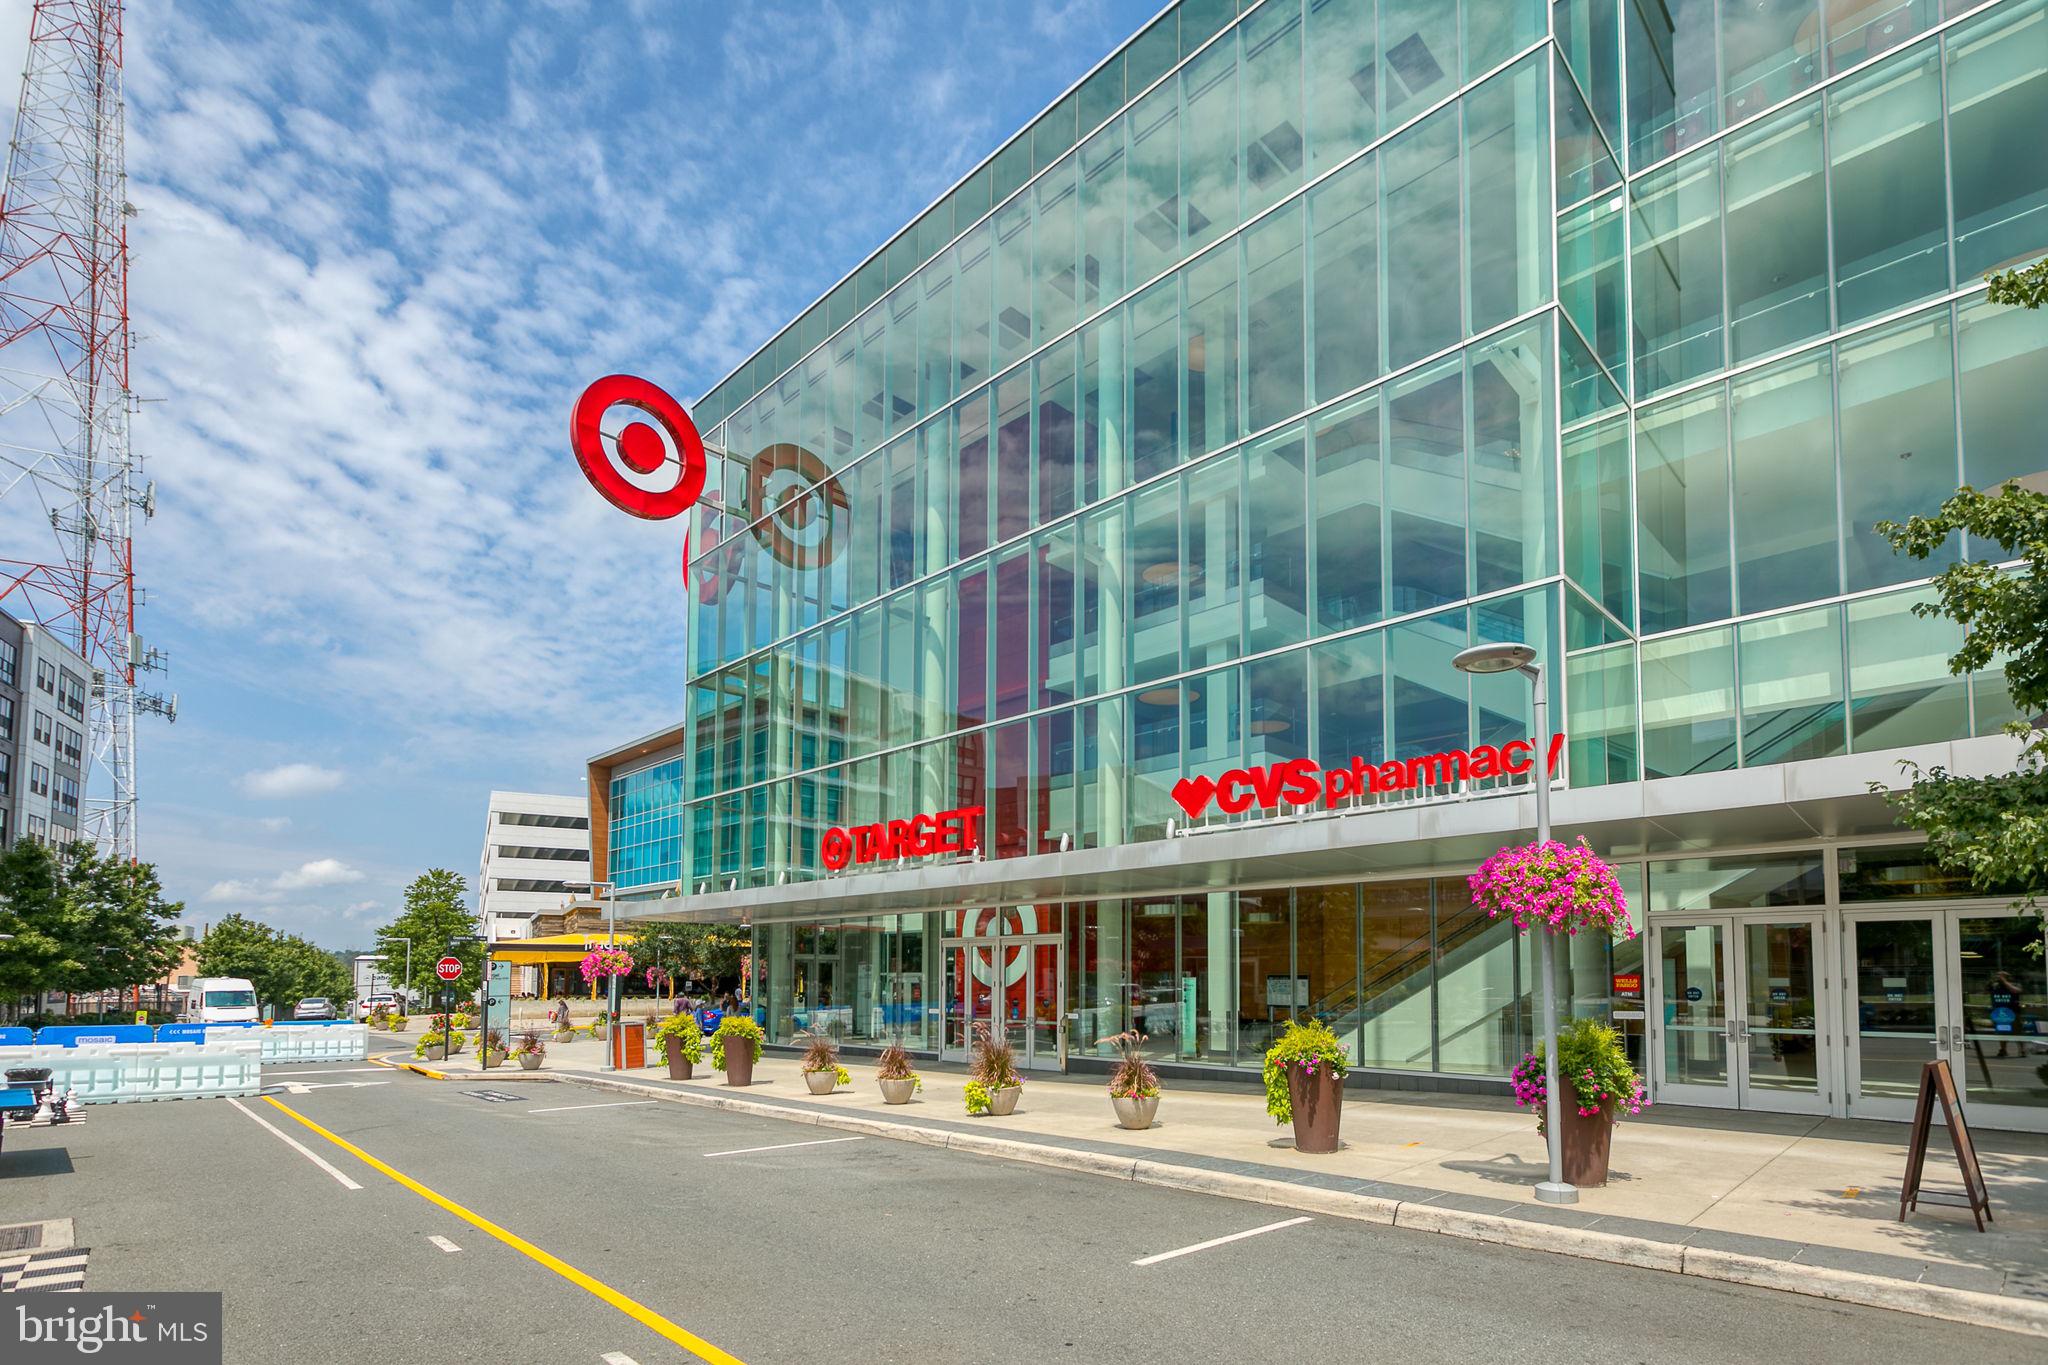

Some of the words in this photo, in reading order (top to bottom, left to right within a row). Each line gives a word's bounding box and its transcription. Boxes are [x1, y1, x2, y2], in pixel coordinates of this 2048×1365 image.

[1216, 758, 1322, 815] CVS
[1326, 732, 1565, 810] pharmacy
[850, 806, 985, 864] TARGET
[439, 964, 461, 973] STOP
[78, 1036, 113, 1044] mosaic
